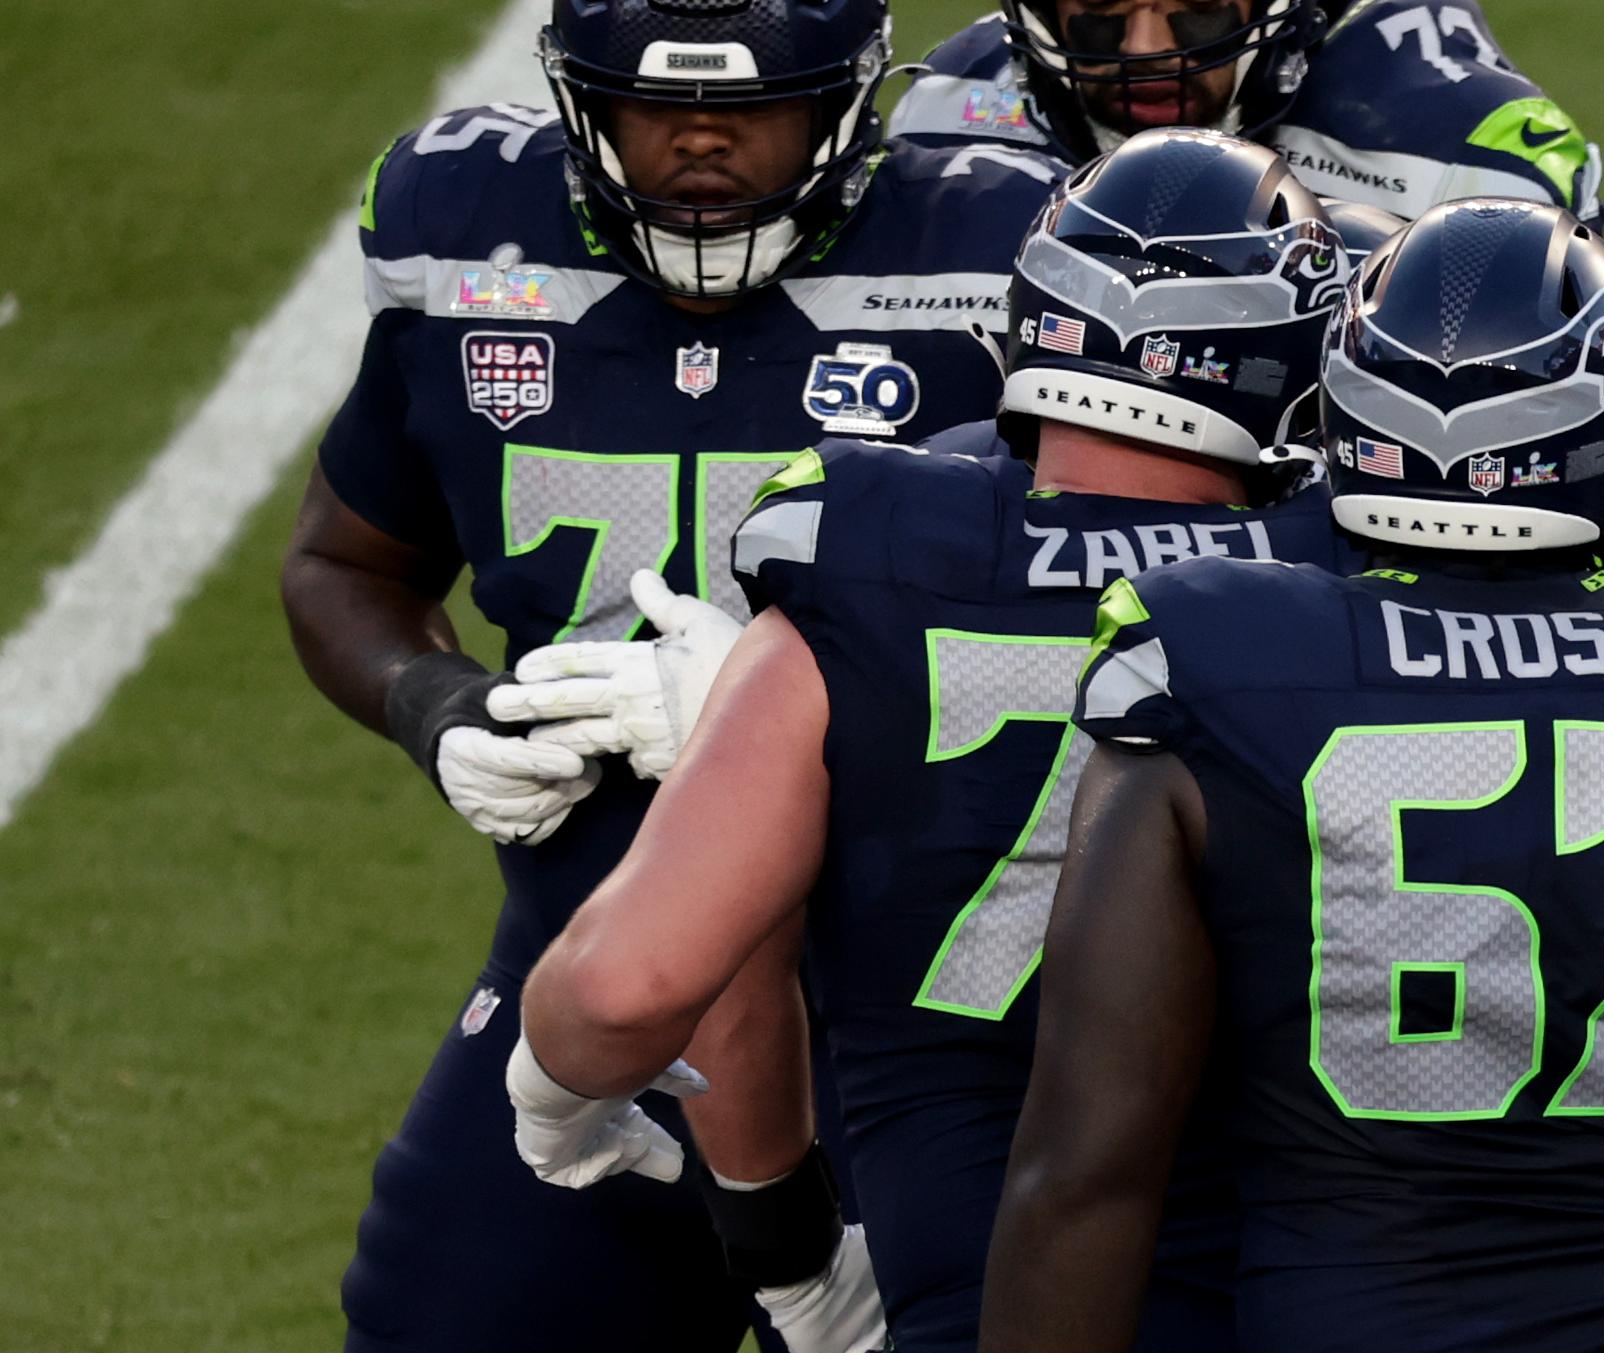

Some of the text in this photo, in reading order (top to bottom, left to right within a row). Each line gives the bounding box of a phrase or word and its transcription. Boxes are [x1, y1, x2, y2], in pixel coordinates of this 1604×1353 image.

[1019, 317, 1037, 345] 45
[470, 344, 545, 366] USA
[1145, 353, 1171, 373] NFL
[683, 368, 711, 386] NFL
[471, 382, 547, 407] 250
[808, 360, 916, 421] 50
[1037, 387, 1197, 435] SEATTLE
[1337, 439, 1354, 468] 45
[1474, 472, 1501, 489] NFL
[1367, 513, 1533, 538] SEATTLE
